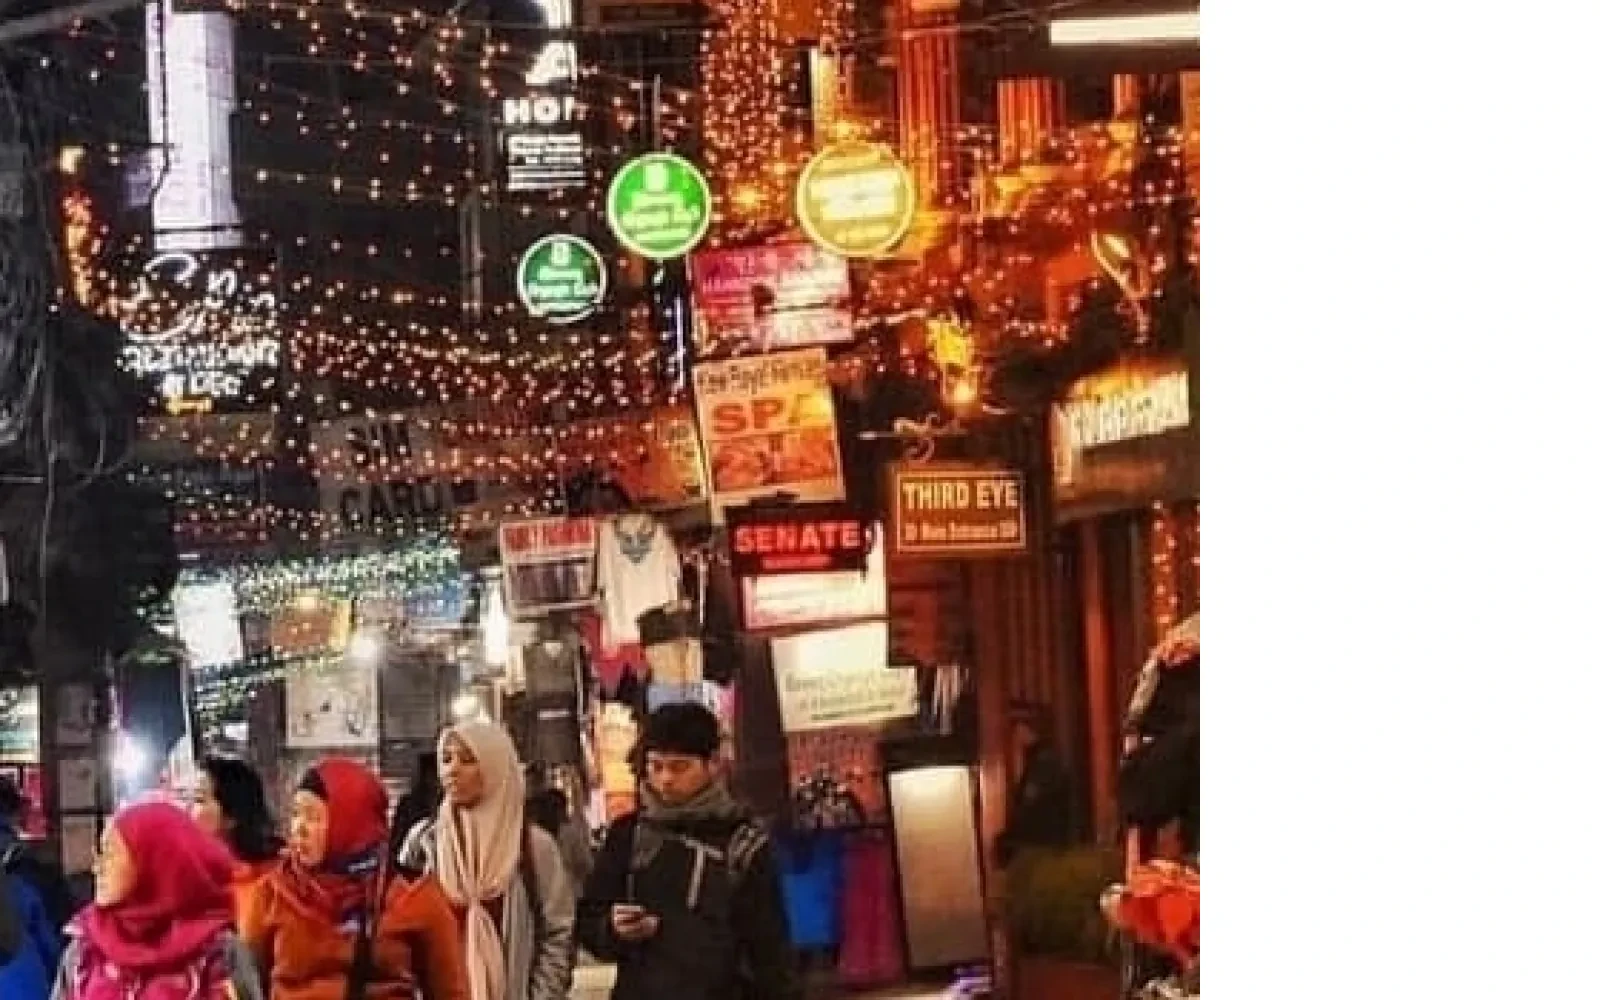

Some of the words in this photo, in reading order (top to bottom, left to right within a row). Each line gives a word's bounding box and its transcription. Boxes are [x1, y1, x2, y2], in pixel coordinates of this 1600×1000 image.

[903, 482, 969, 510] THIRD
[976, 479, 1018, 509] EYE
[735, 520, 860, 553] SENATE
